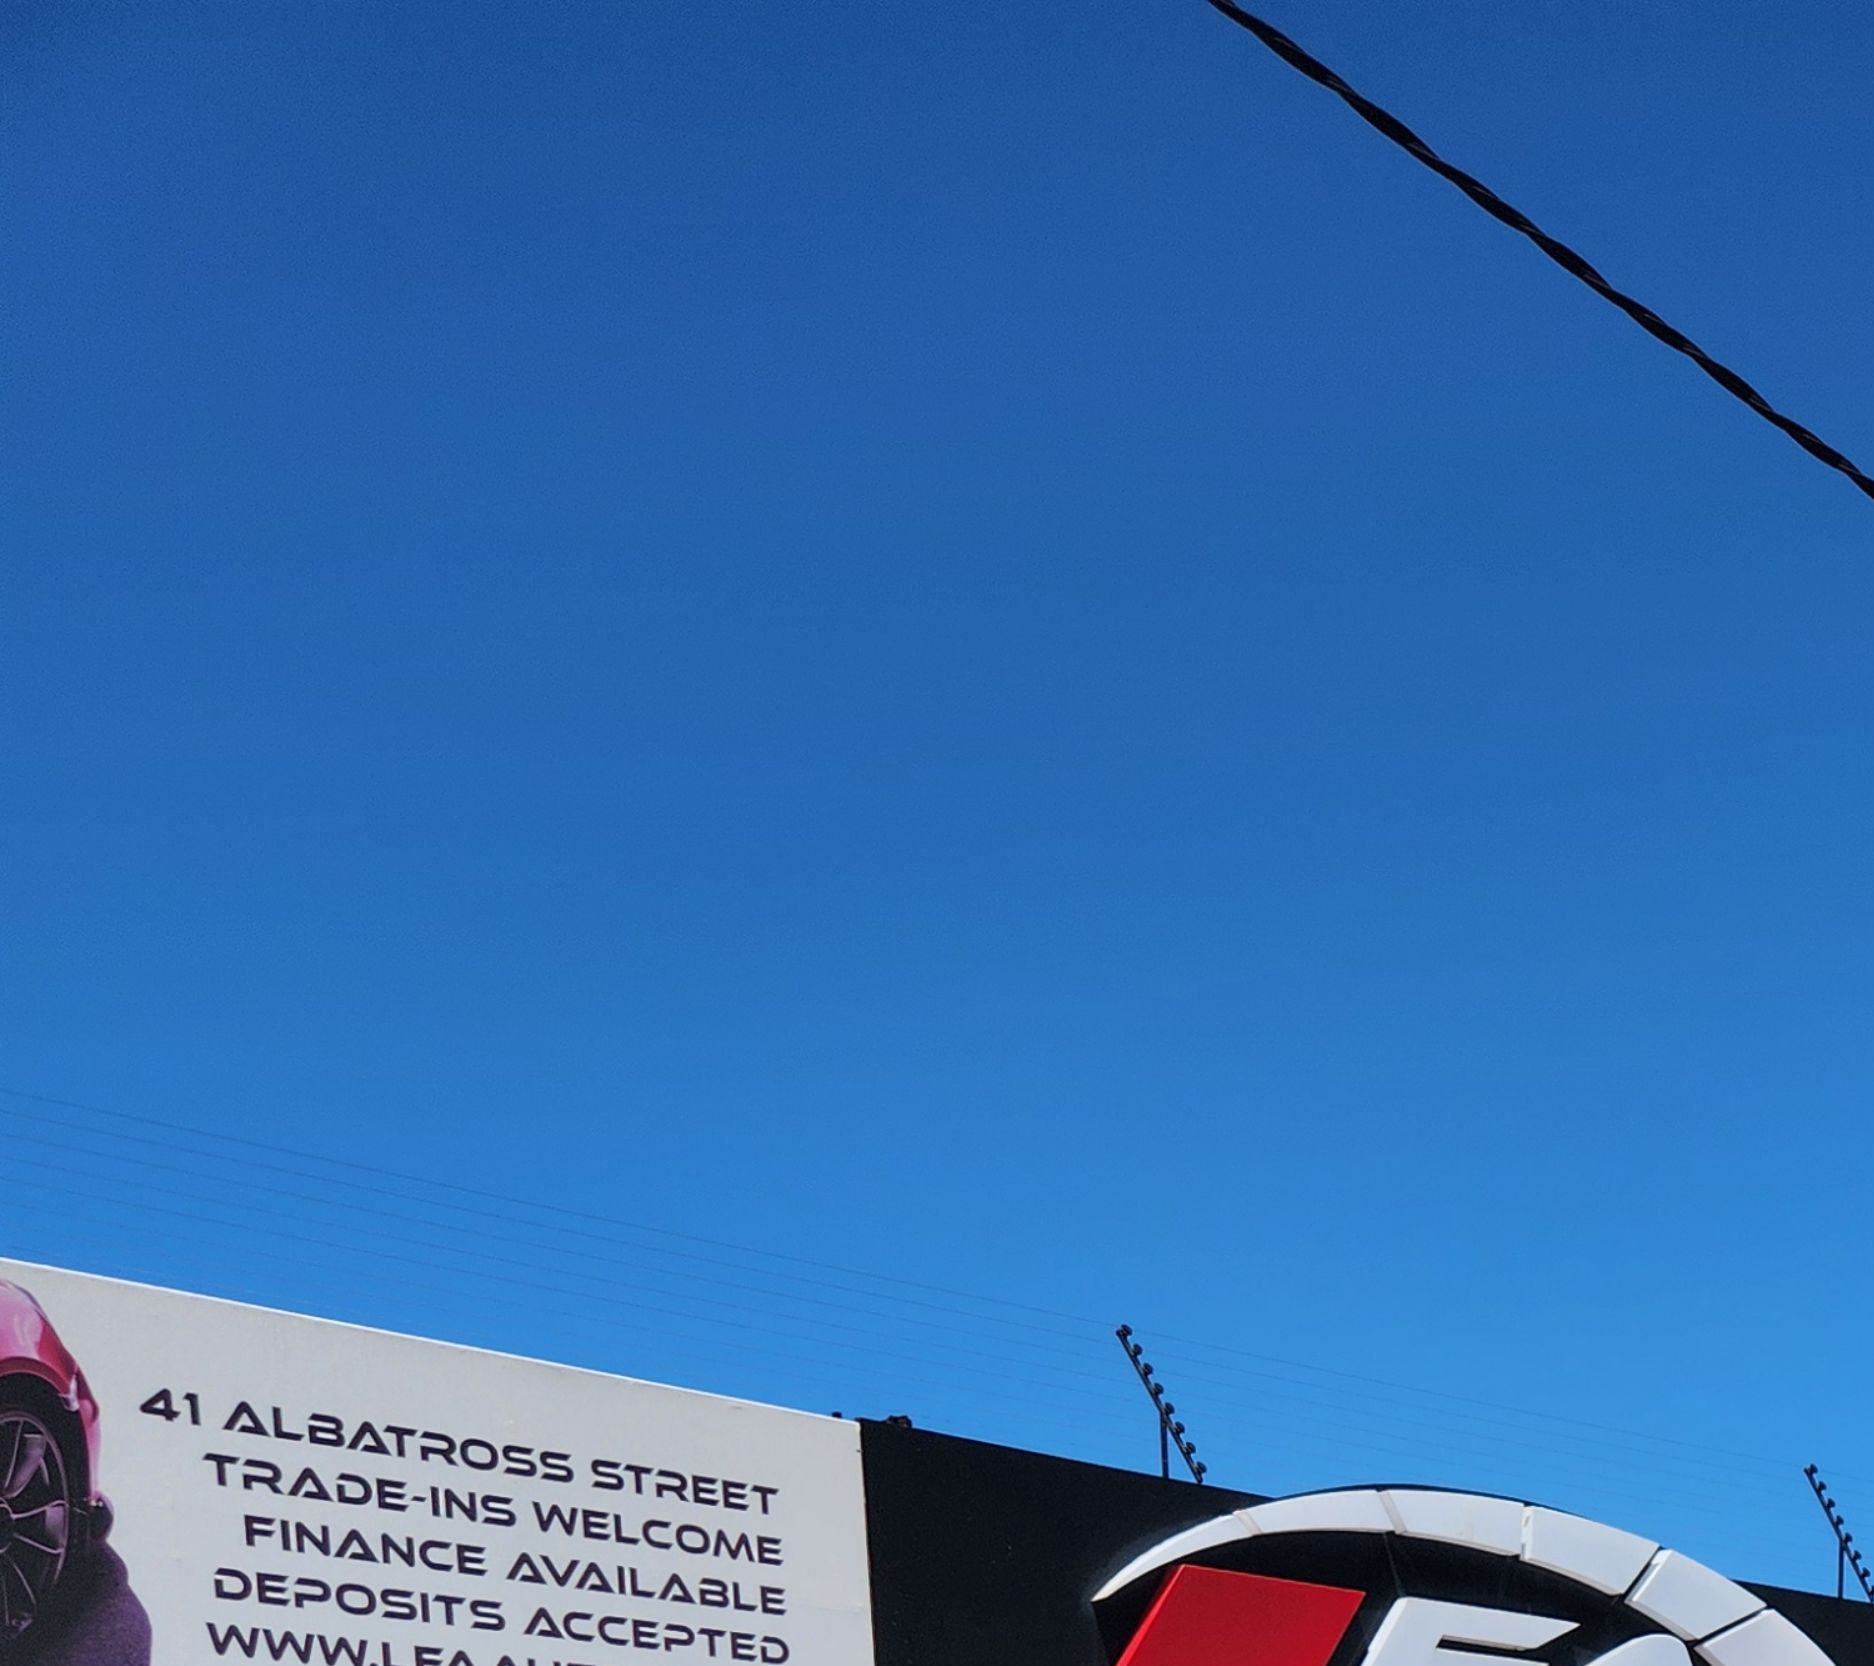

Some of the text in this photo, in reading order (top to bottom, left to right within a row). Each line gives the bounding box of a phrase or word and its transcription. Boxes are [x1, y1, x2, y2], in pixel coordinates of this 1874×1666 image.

[139, 1388, 780, 1515] 41 ALBATROSS STREET
[202, 1453, 784, 1566] TRADE-INS WELCOME
[213, 1567, 789, 1665] DEPOSITS ACCEPTED
[243, 1514, 788, 1615] FINANCE AVAILABLE
